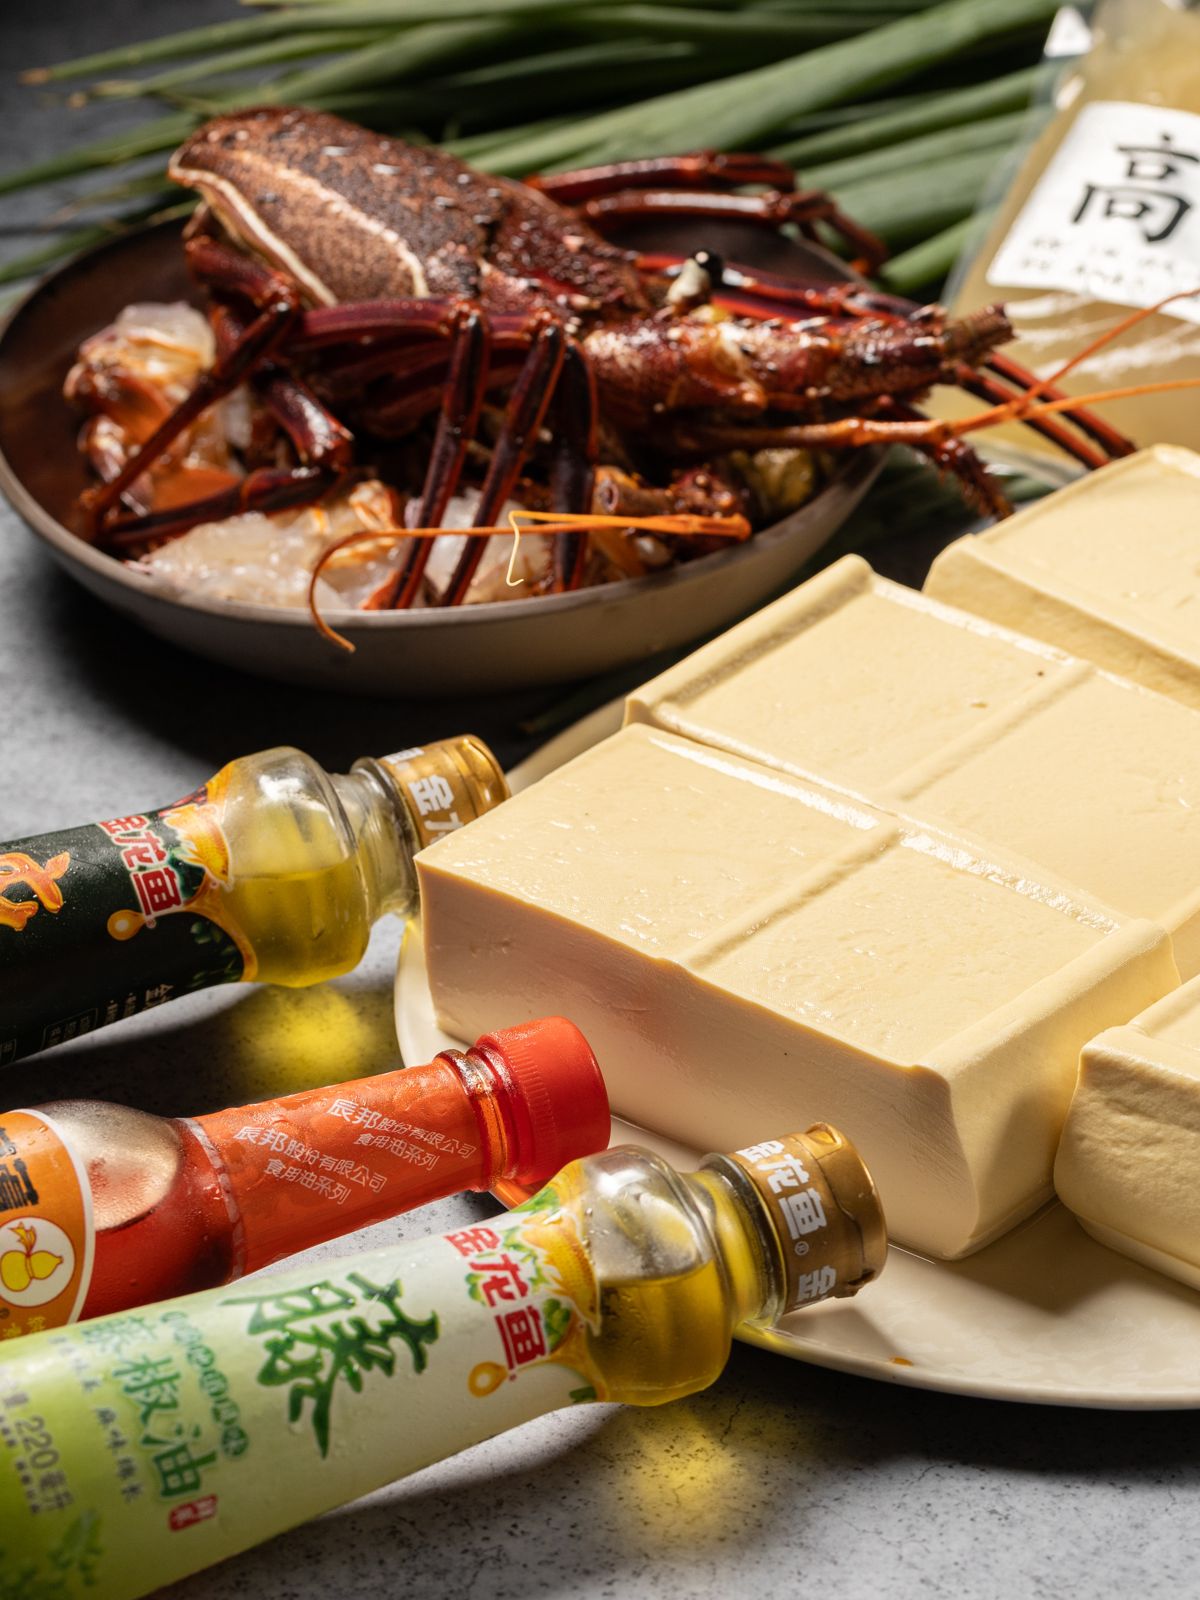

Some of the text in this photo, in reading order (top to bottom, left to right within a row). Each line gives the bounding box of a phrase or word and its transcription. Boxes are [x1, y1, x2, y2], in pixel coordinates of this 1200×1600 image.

[97, 815, 186, 916] 金龙鱼
[233, 1125, 388, 1193] 辰邦股份有限公司
[327, 1098, 477, 1159] 辰邦股份有限公司
[353, 1133, 440, 1171] 食用油系列
[264, 1158, 352, 1205] 食用油系列
[736, 1140, 827, 1240] 金龙鱼
[444, 1227, 549, 1371] 金龙鱼
